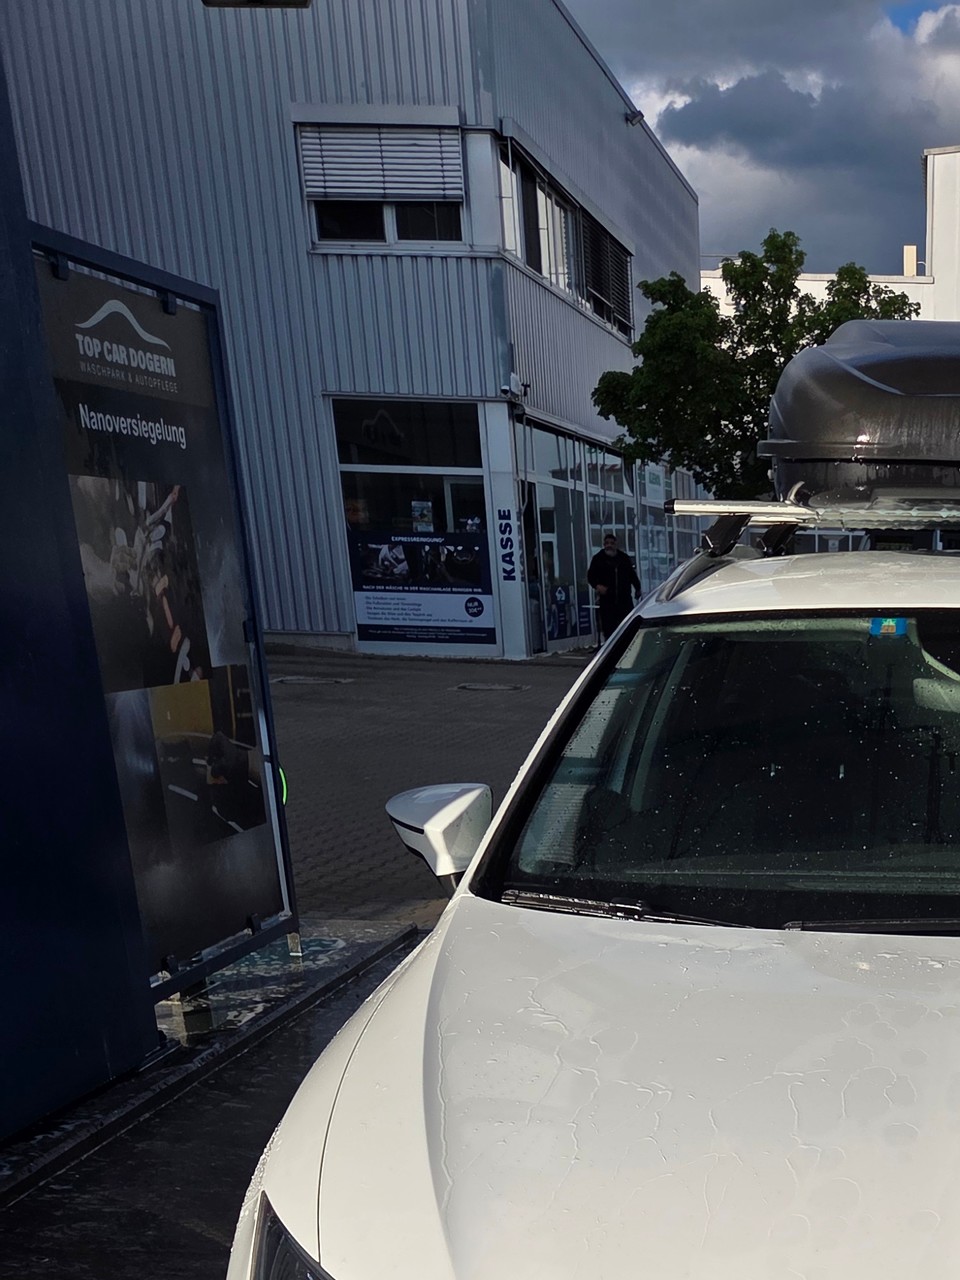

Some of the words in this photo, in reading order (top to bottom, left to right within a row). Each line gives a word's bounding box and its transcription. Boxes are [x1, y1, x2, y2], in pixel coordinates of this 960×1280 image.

[76, 334, 102, 358] TOP
[104, 340, 128, 366] CAR
[130, 348, 176, 378] DOGERN
[135, 374, 179, 394] AUTOPFLEGE
[78, 402, 186, 450] Nanoversiegelung
[498, 509, 516, 581] KASSE
